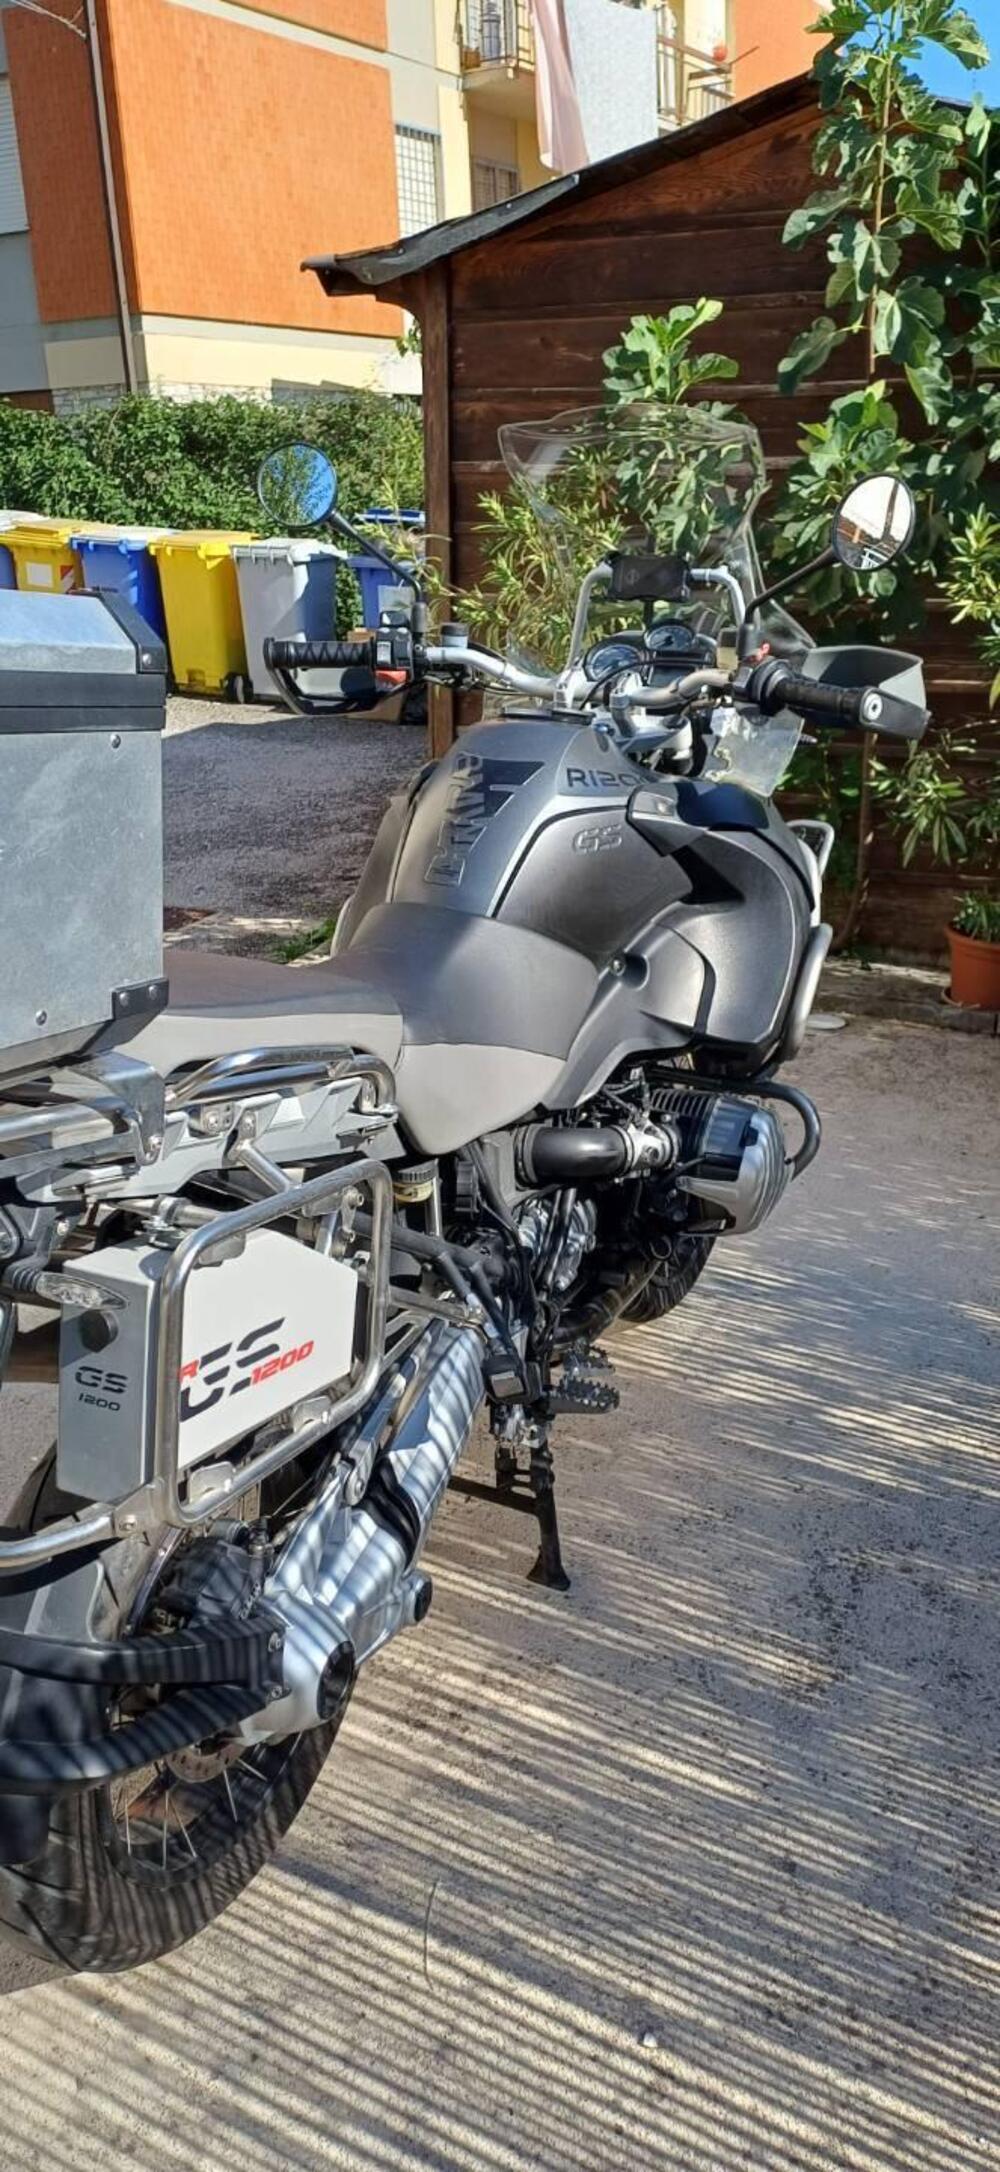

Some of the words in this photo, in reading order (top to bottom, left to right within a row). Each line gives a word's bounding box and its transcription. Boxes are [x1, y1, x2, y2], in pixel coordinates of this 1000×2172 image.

[573, 823, 622, 855] GS
[75, 1366, 128, 1395] GS
[180, 1317, 286, 1423] GS
[250, 1340, 315, 1385] 1200
[79, 1393, 121, 1412] 1200
